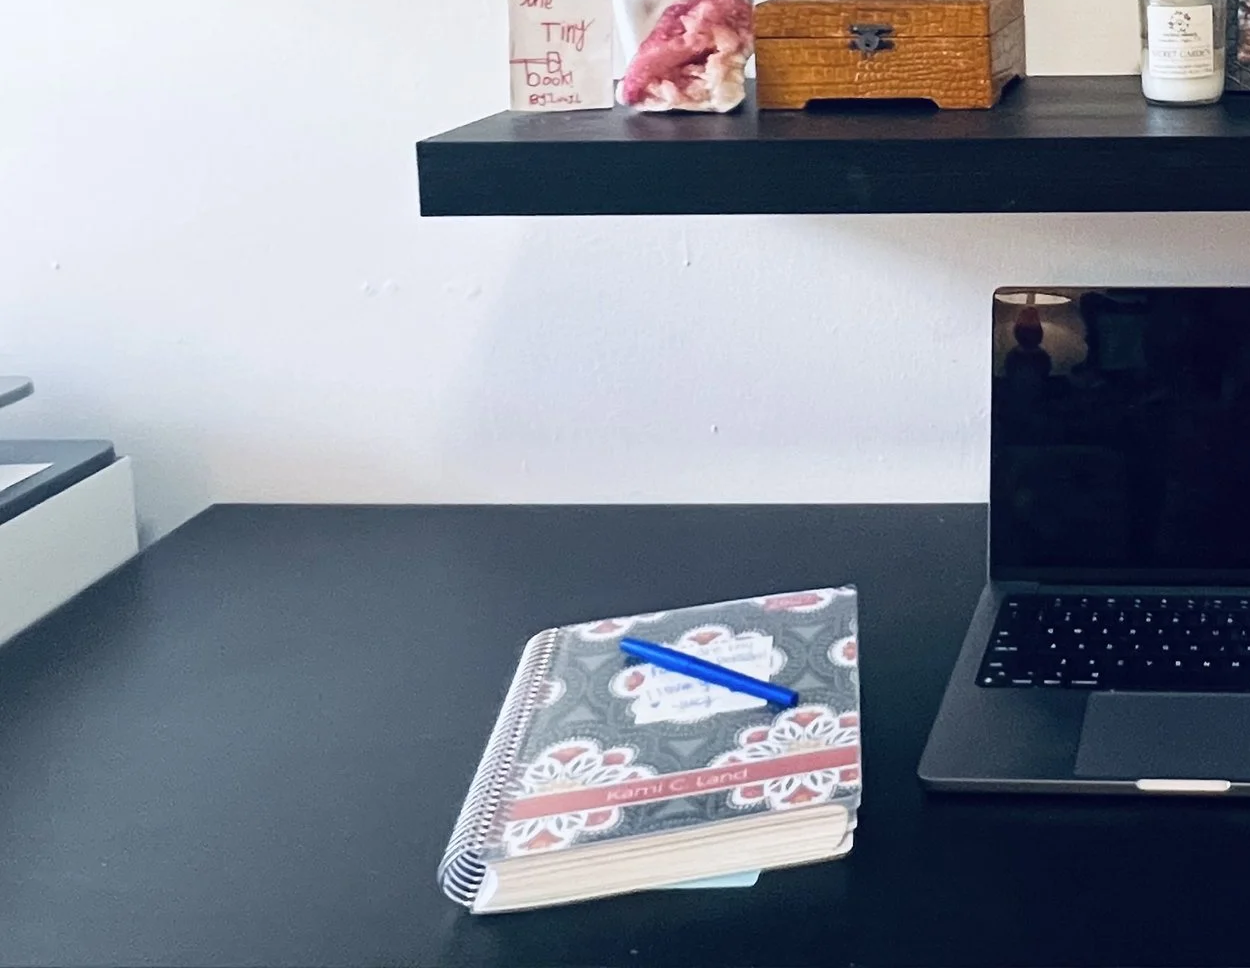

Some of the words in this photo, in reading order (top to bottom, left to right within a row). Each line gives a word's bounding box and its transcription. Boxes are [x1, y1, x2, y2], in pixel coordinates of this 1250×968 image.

[540, 18, 595, 52] Tiny
[606, 784, 663, 801] Kami
[696, 768, 748, 788] Land
